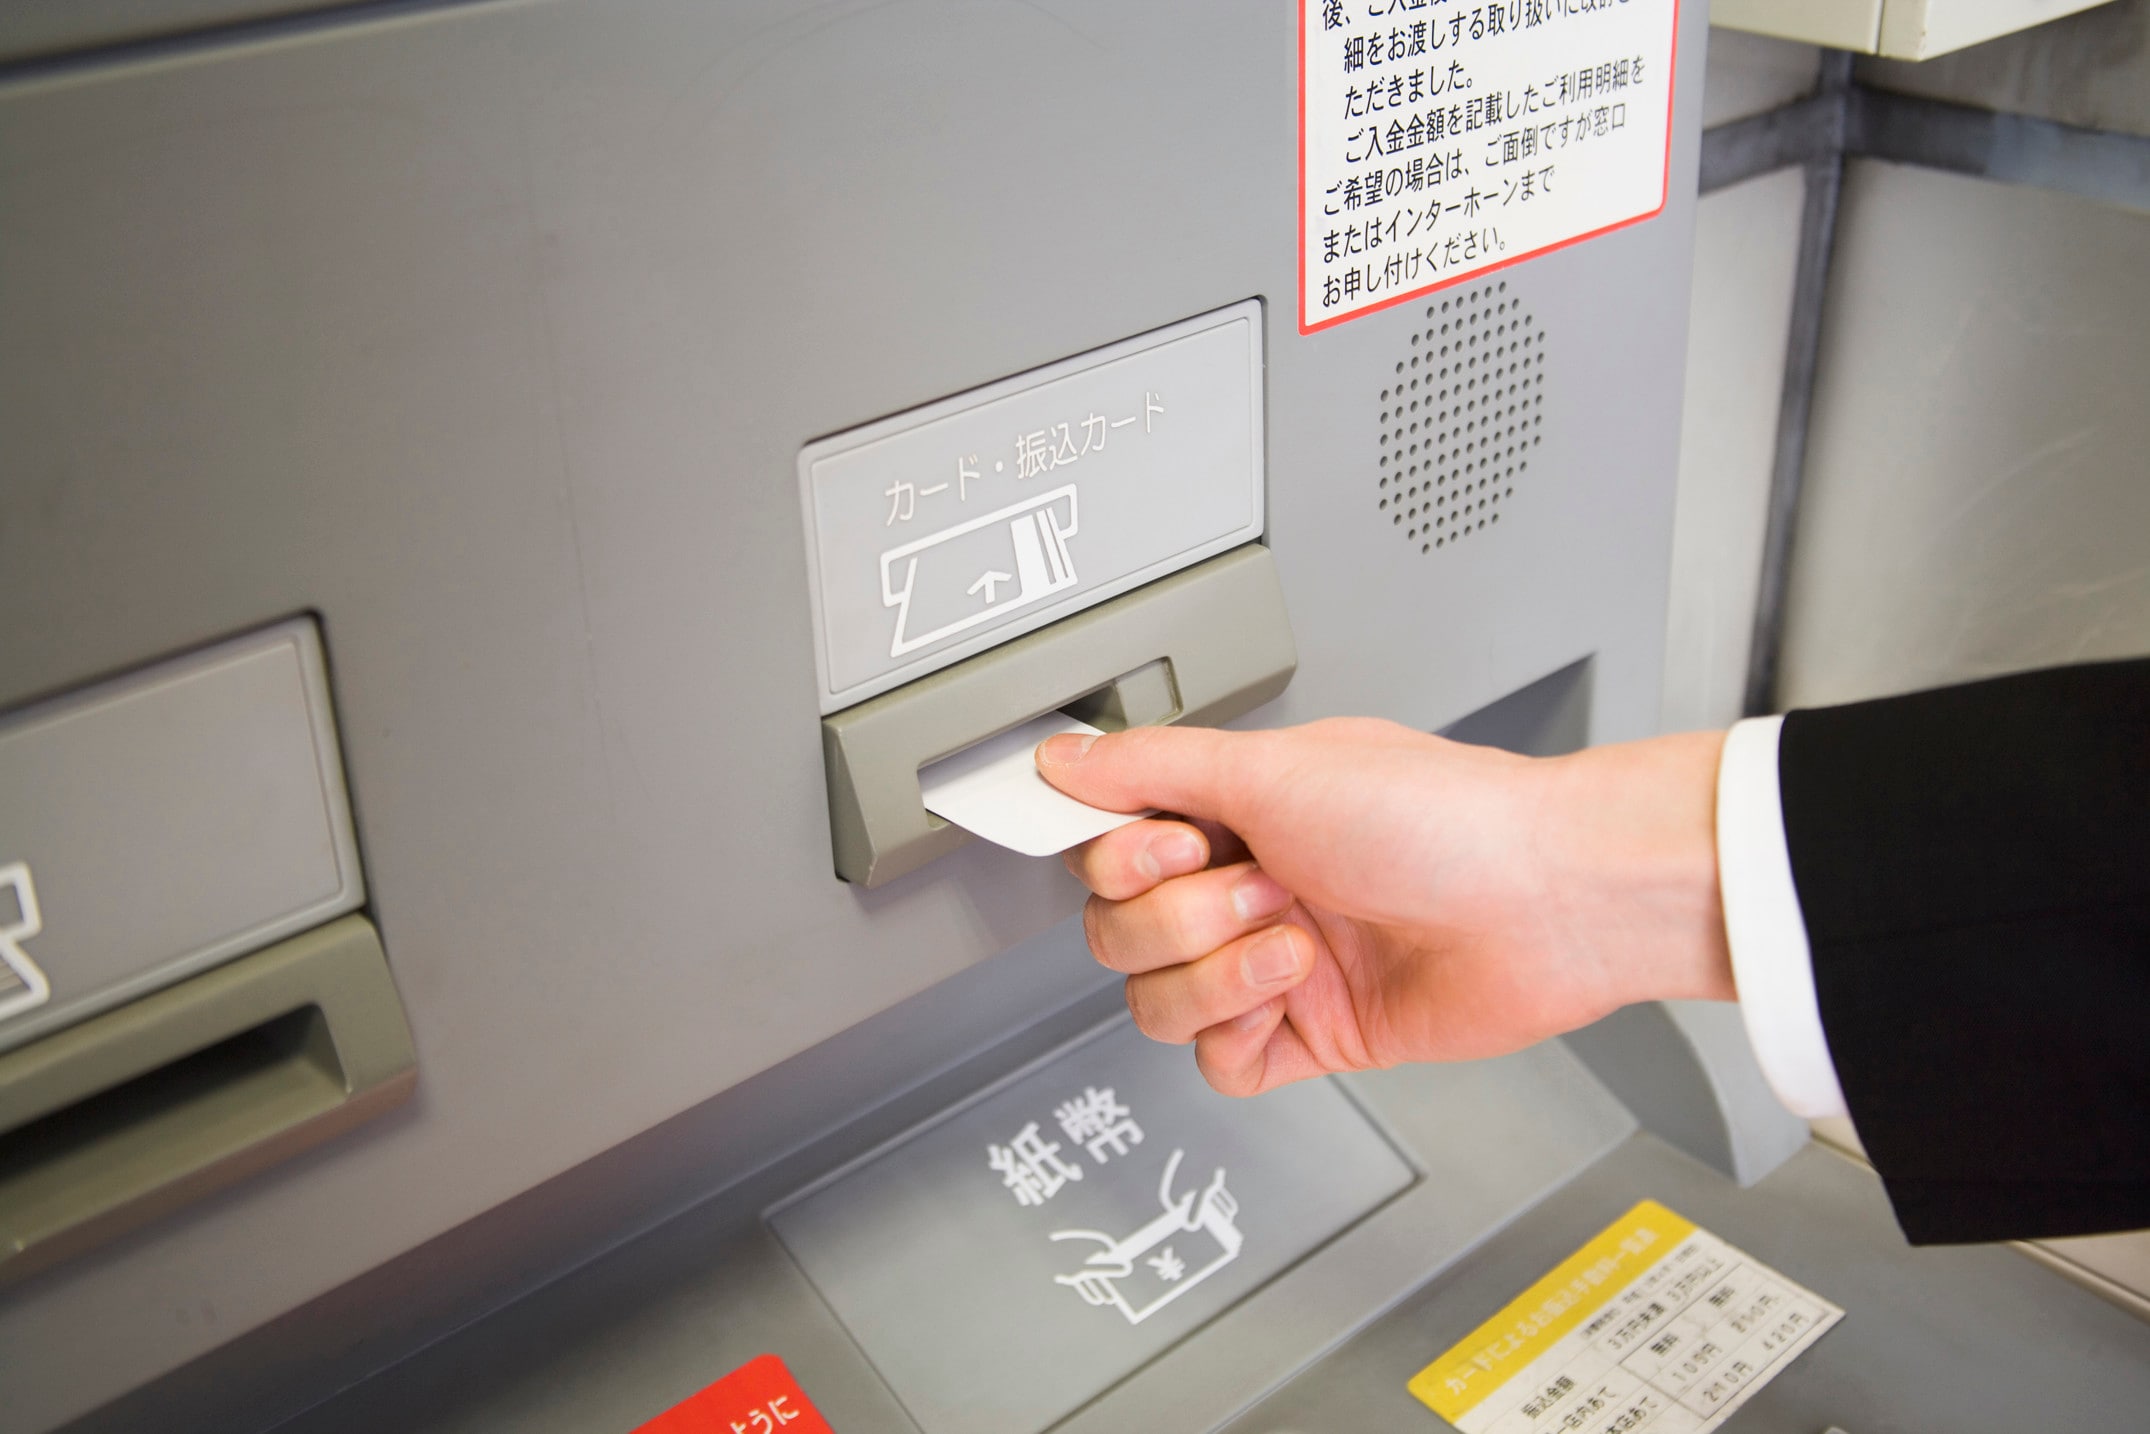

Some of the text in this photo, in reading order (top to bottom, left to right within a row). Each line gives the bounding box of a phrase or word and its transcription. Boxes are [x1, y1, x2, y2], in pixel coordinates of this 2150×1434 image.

[1344, 0, 1632, 74] 細をお渡しする取り扱いに
[1344, 59, 1474, 120] ただきました。
[1346, 55, 1646, 163] ご入金金額を記載したご利用明細を
[1323, 164, 1556, 264] またはインターホーンまで
[1322, 226, 1507, 308] お申し付けください。
[885, 391, 1165, 527] カード・振込カード
[986, 1086, 1146, 1206] 紙幣
